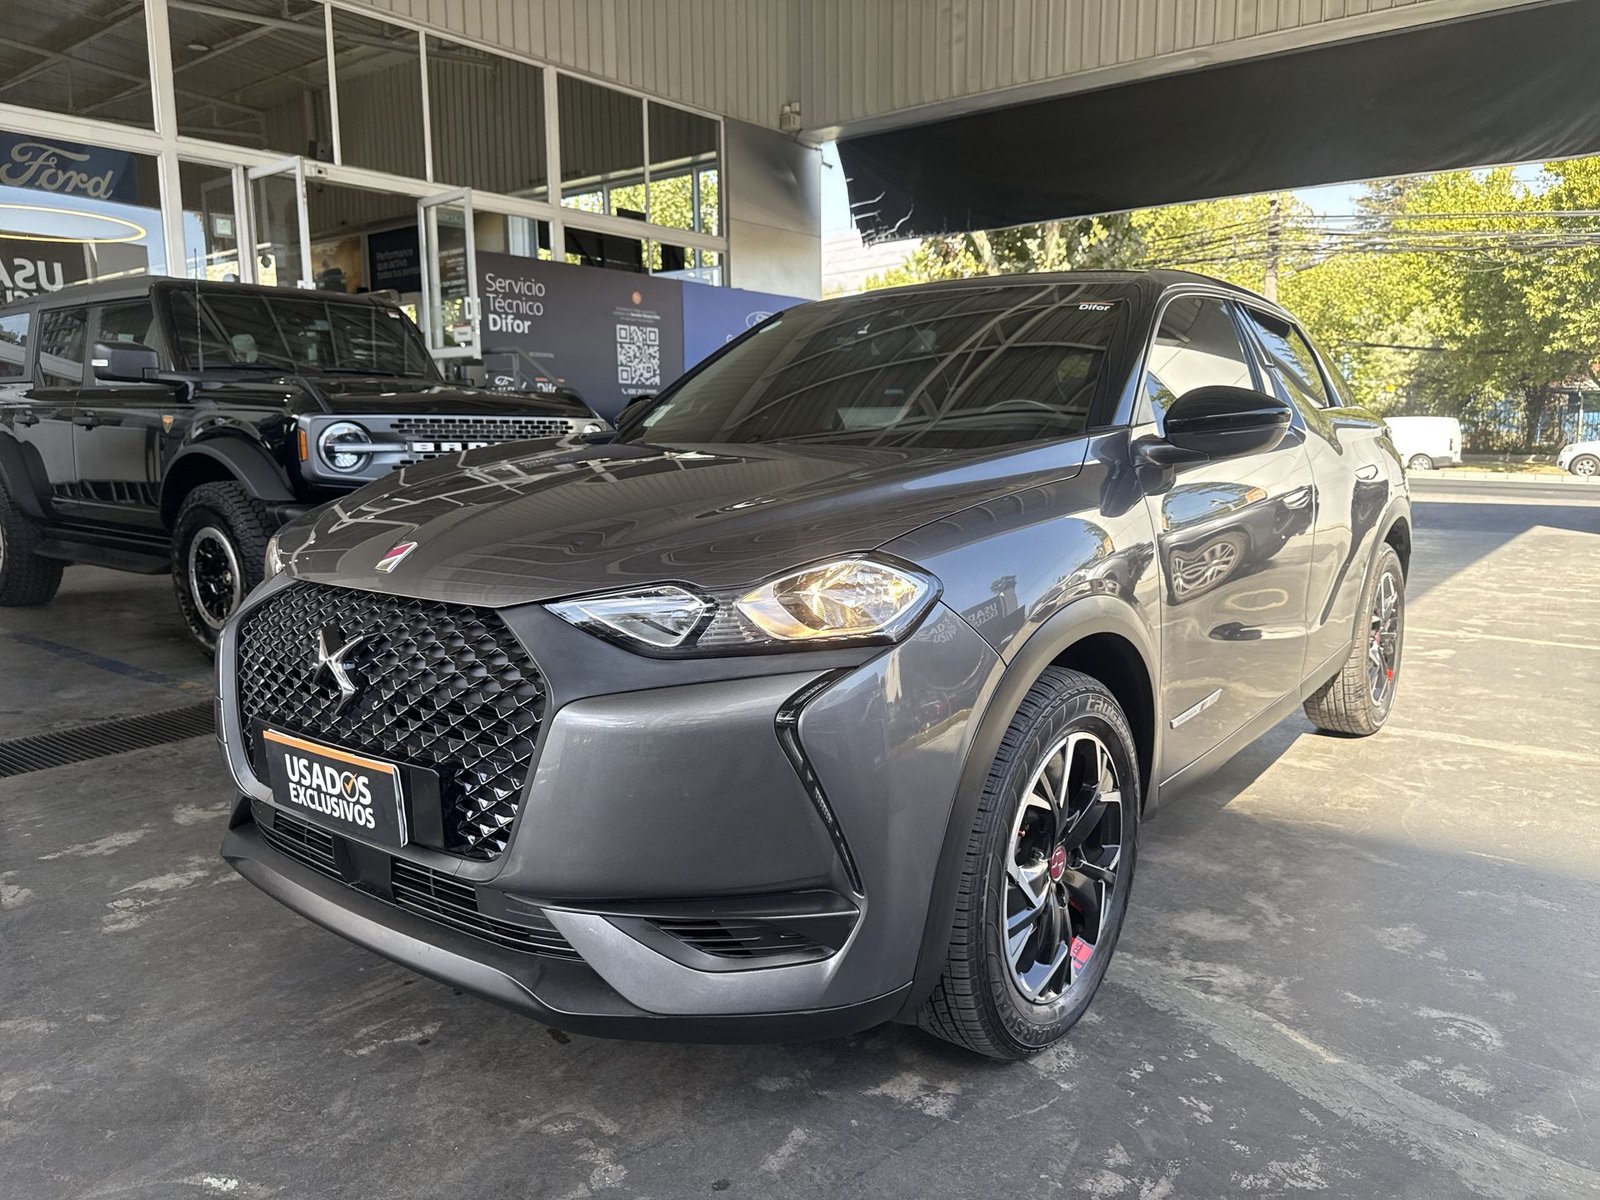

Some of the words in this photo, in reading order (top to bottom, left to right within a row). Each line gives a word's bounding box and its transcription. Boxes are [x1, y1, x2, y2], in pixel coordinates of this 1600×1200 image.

[0, 142, 114, 199] Ford
[485, 273, 546, 297] Servicio
[486, 293, 544, 316] Técnico
[488, 313, 532, 334] Difor
[412, 442, 502, 452] BRO
[284, 753, 372, 805] USADOS
[288, 782, 376, 830] EXCLUSIVOS
